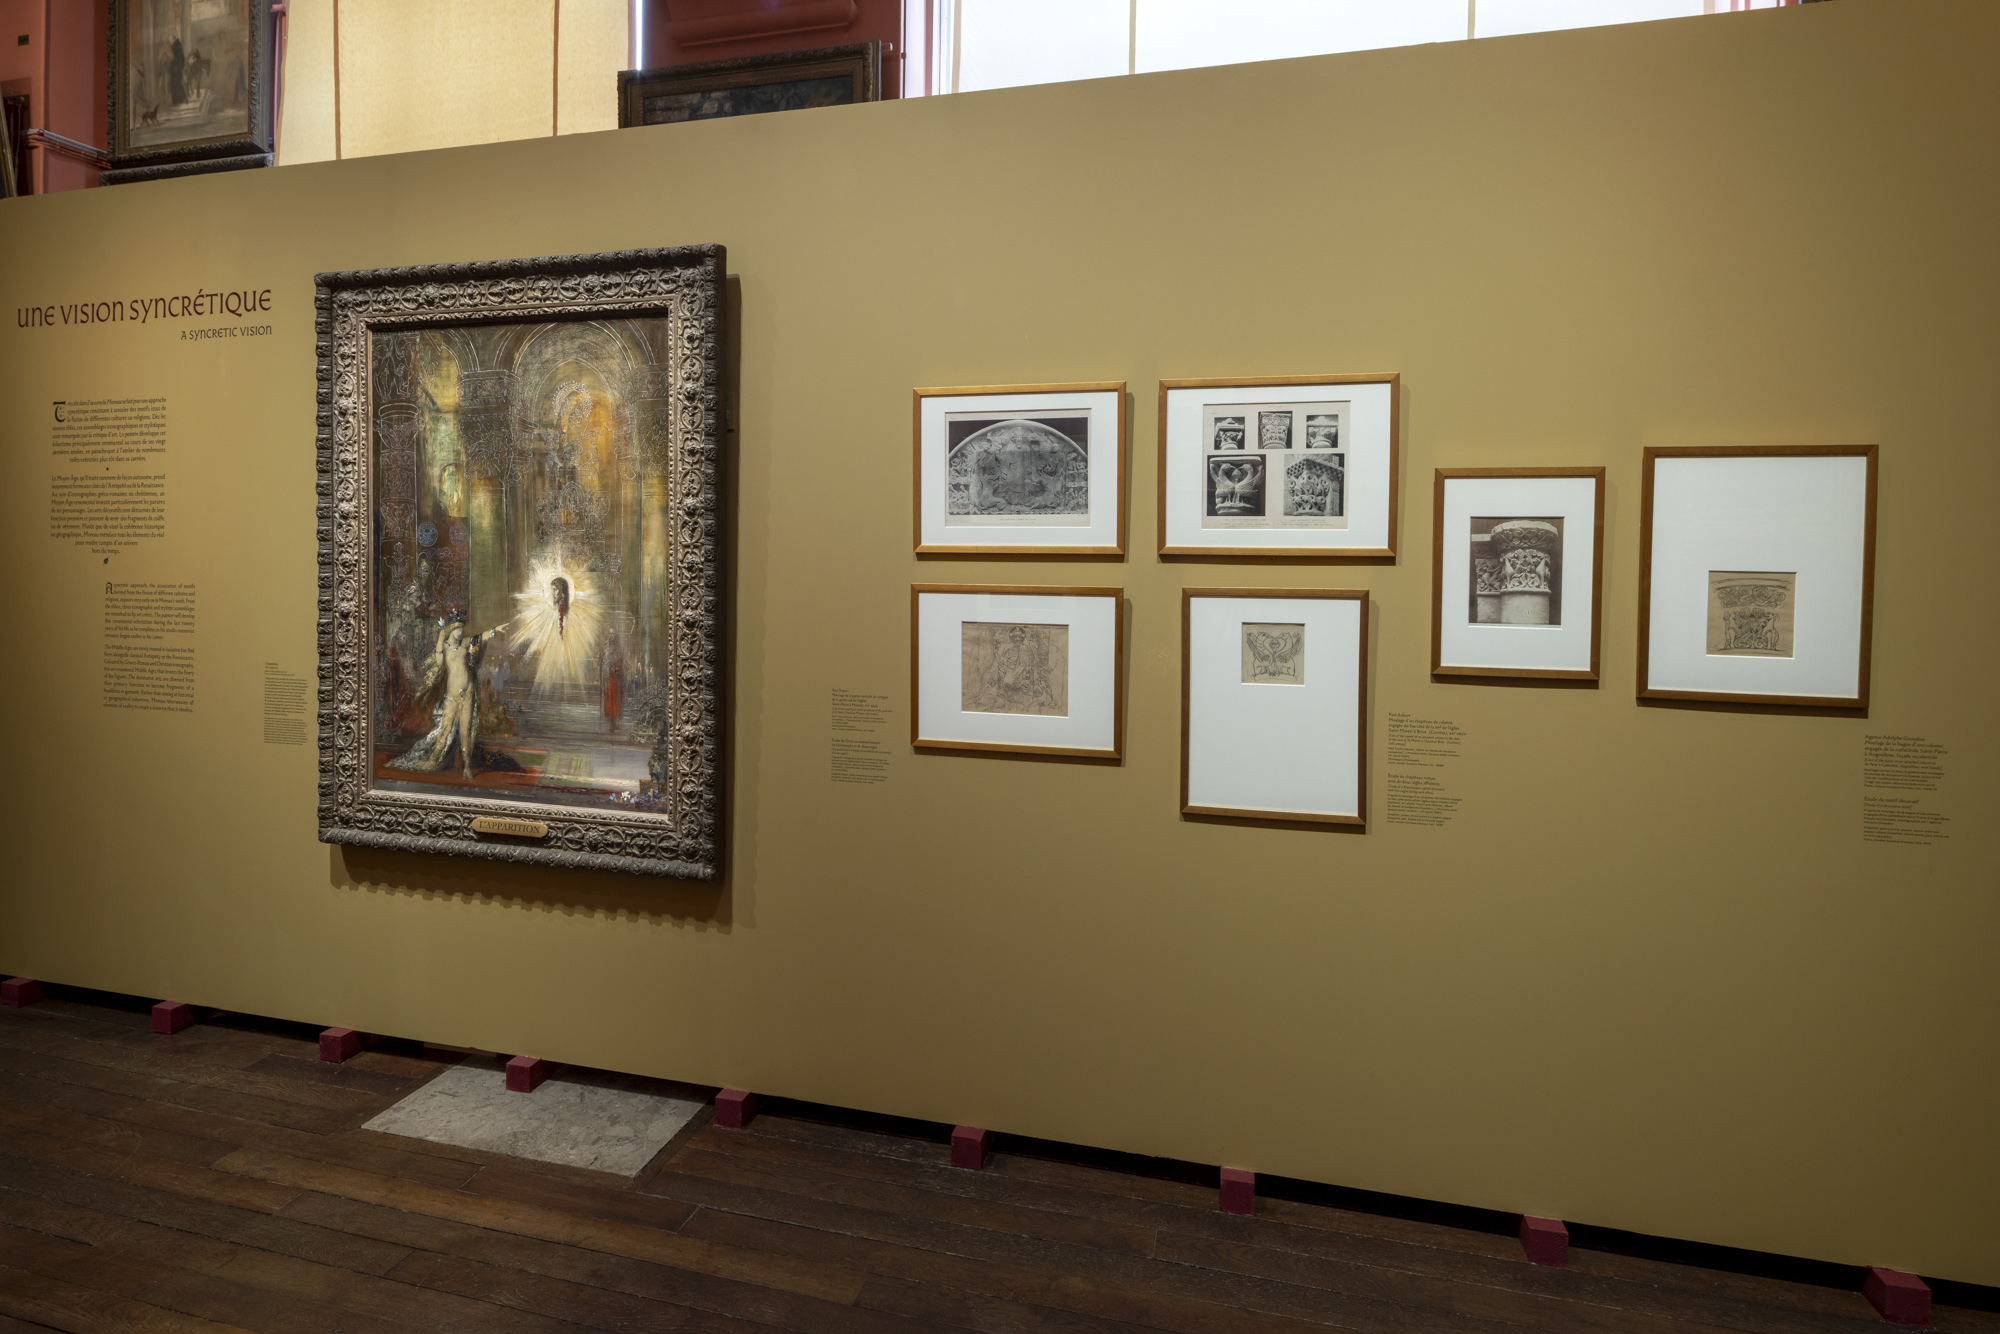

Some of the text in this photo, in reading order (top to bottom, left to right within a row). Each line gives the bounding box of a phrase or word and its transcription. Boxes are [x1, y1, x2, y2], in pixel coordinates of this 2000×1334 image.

[60, 300, 124, 324] VISION
[129, 289, 272, 323] SYNCRÉTIQUE
[189, 327, 238, 341] SYNCRETIC
[240, 326, 272, 336] VISION
[479, 821, 540, 833] L'APPARITION
